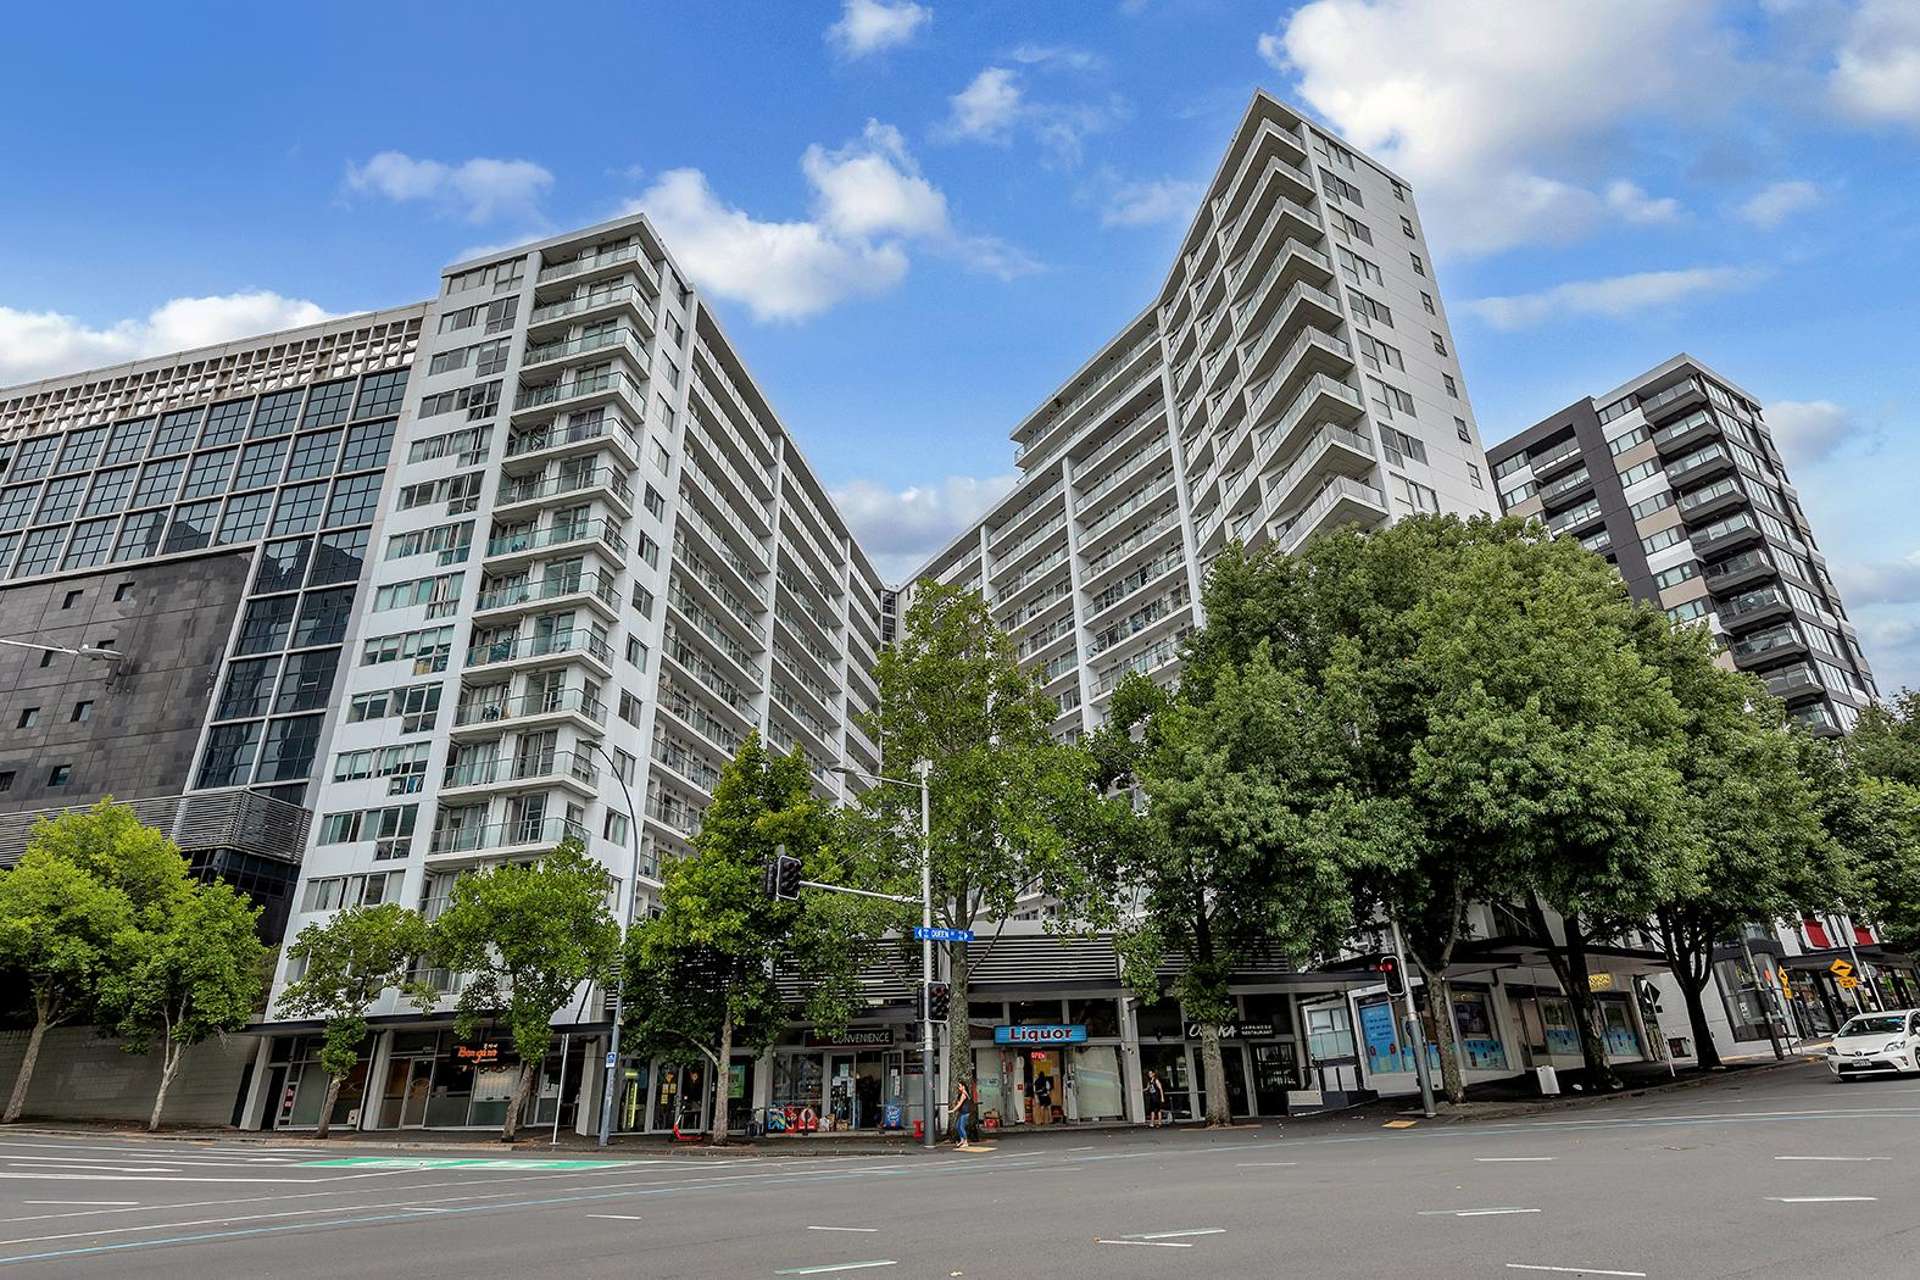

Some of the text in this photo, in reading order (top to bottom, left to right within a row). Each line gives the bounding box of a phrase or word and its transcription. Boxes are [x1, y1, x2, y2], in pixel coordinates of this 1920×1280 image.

[931, 929, 949, 938] QUEEN
[1009, 1026, 1073, 1043] Liquor
[1189, 1024, 1237, 1038] OKA
[832, 1032, 889, 1044] CONVENIENCE
[1031, 1051, 1045, 1059] OPEN
